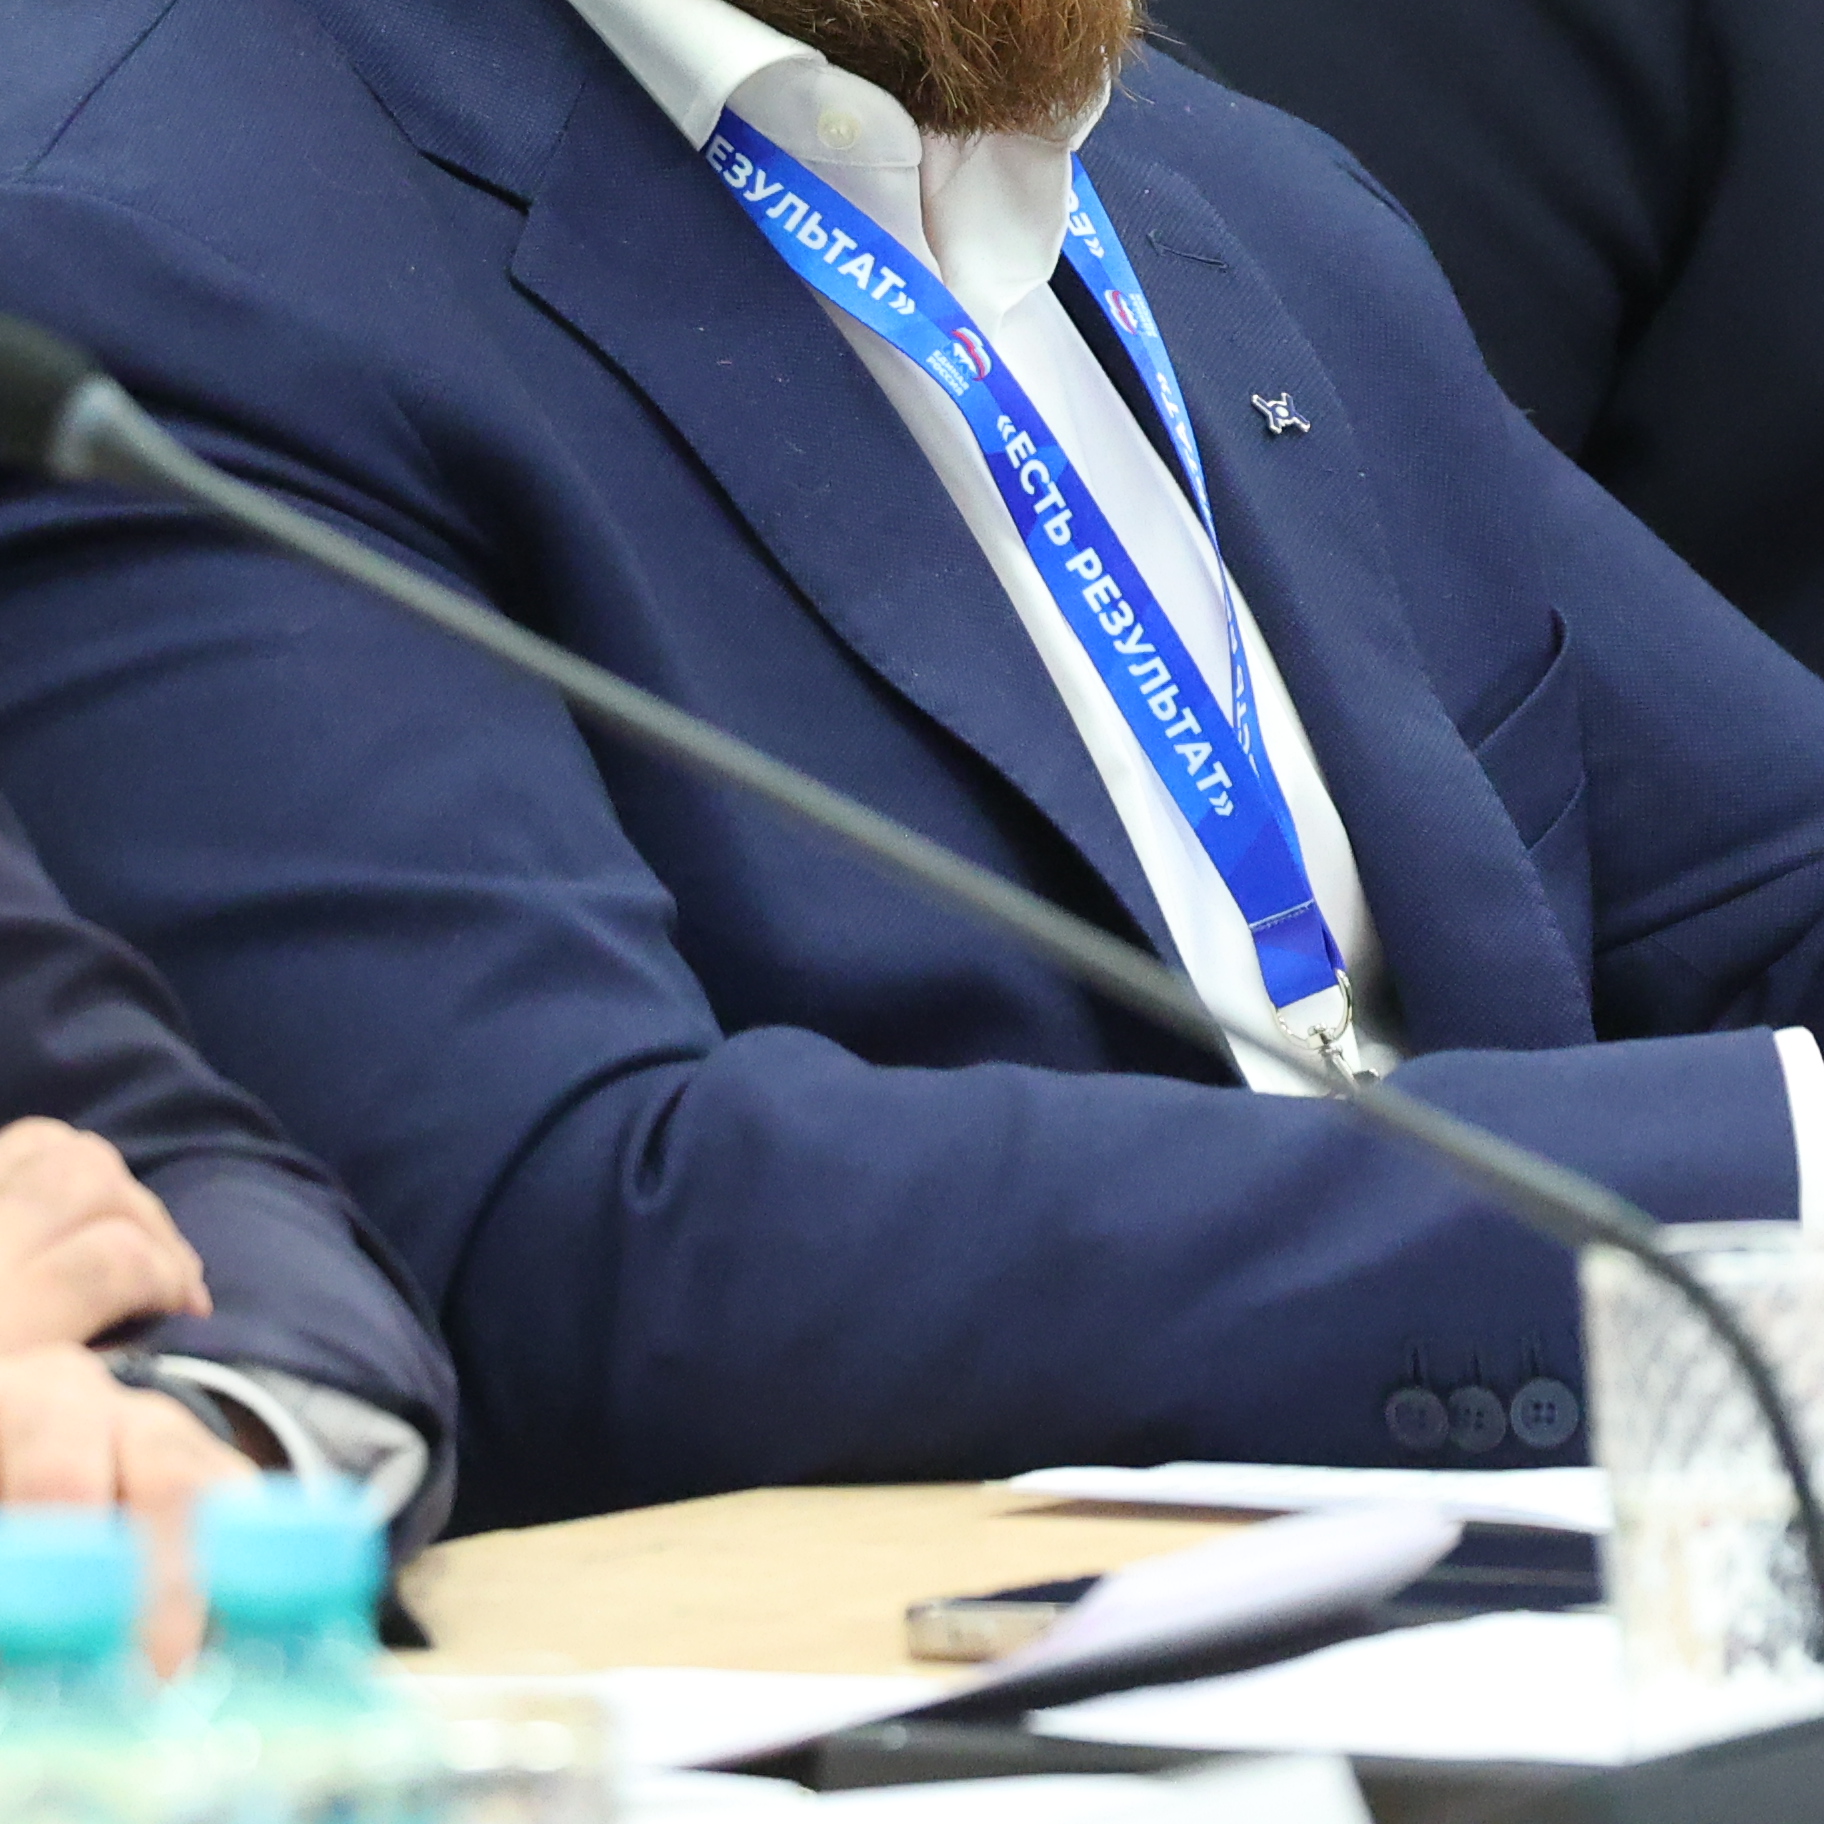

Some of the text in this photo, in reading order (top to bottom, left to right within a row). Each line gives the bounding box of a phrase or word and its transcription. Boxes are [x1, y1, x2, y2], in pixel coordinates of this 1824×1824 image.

[705, 133, 916, 315] ЕЗУЛЬТАТ»
[995, 413, 1072, 548] «ЕСТЬ
[1065, 547, 1233, 817] РЕЗУЛЬТАТ»
